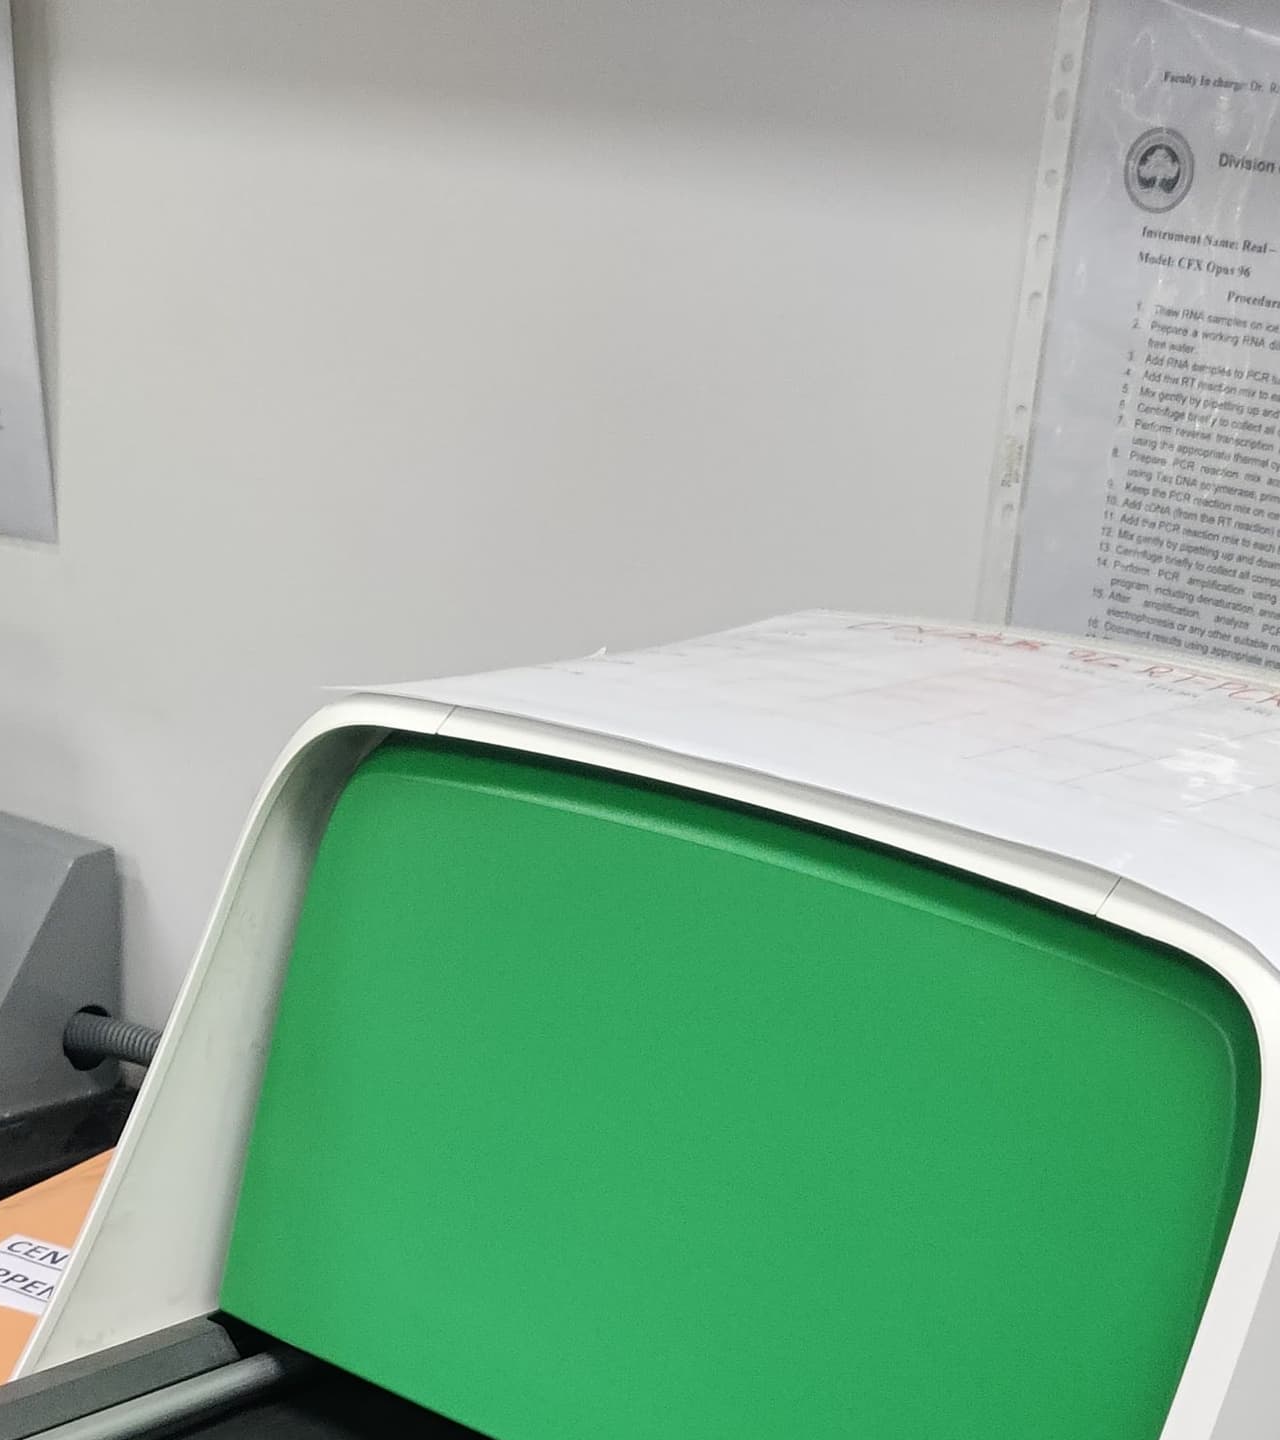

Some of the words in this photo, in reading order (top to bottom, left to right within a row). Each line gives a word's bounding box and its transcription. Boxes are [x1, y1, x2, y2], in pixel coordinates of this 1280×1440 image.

[1218, 152, 1275, 172] Division
[1141, 225, 1200, 244] Instrument
[1203, 234, 1238, 249] Name:
[1241, 239, 1268, 253] Real
[1177, 256, 1203, 271] CFX
[1205, 260, 1235, 277] Opus
[1237, 265, 1251, 278] 96
[1242, 334, 1265, 347] RNA
